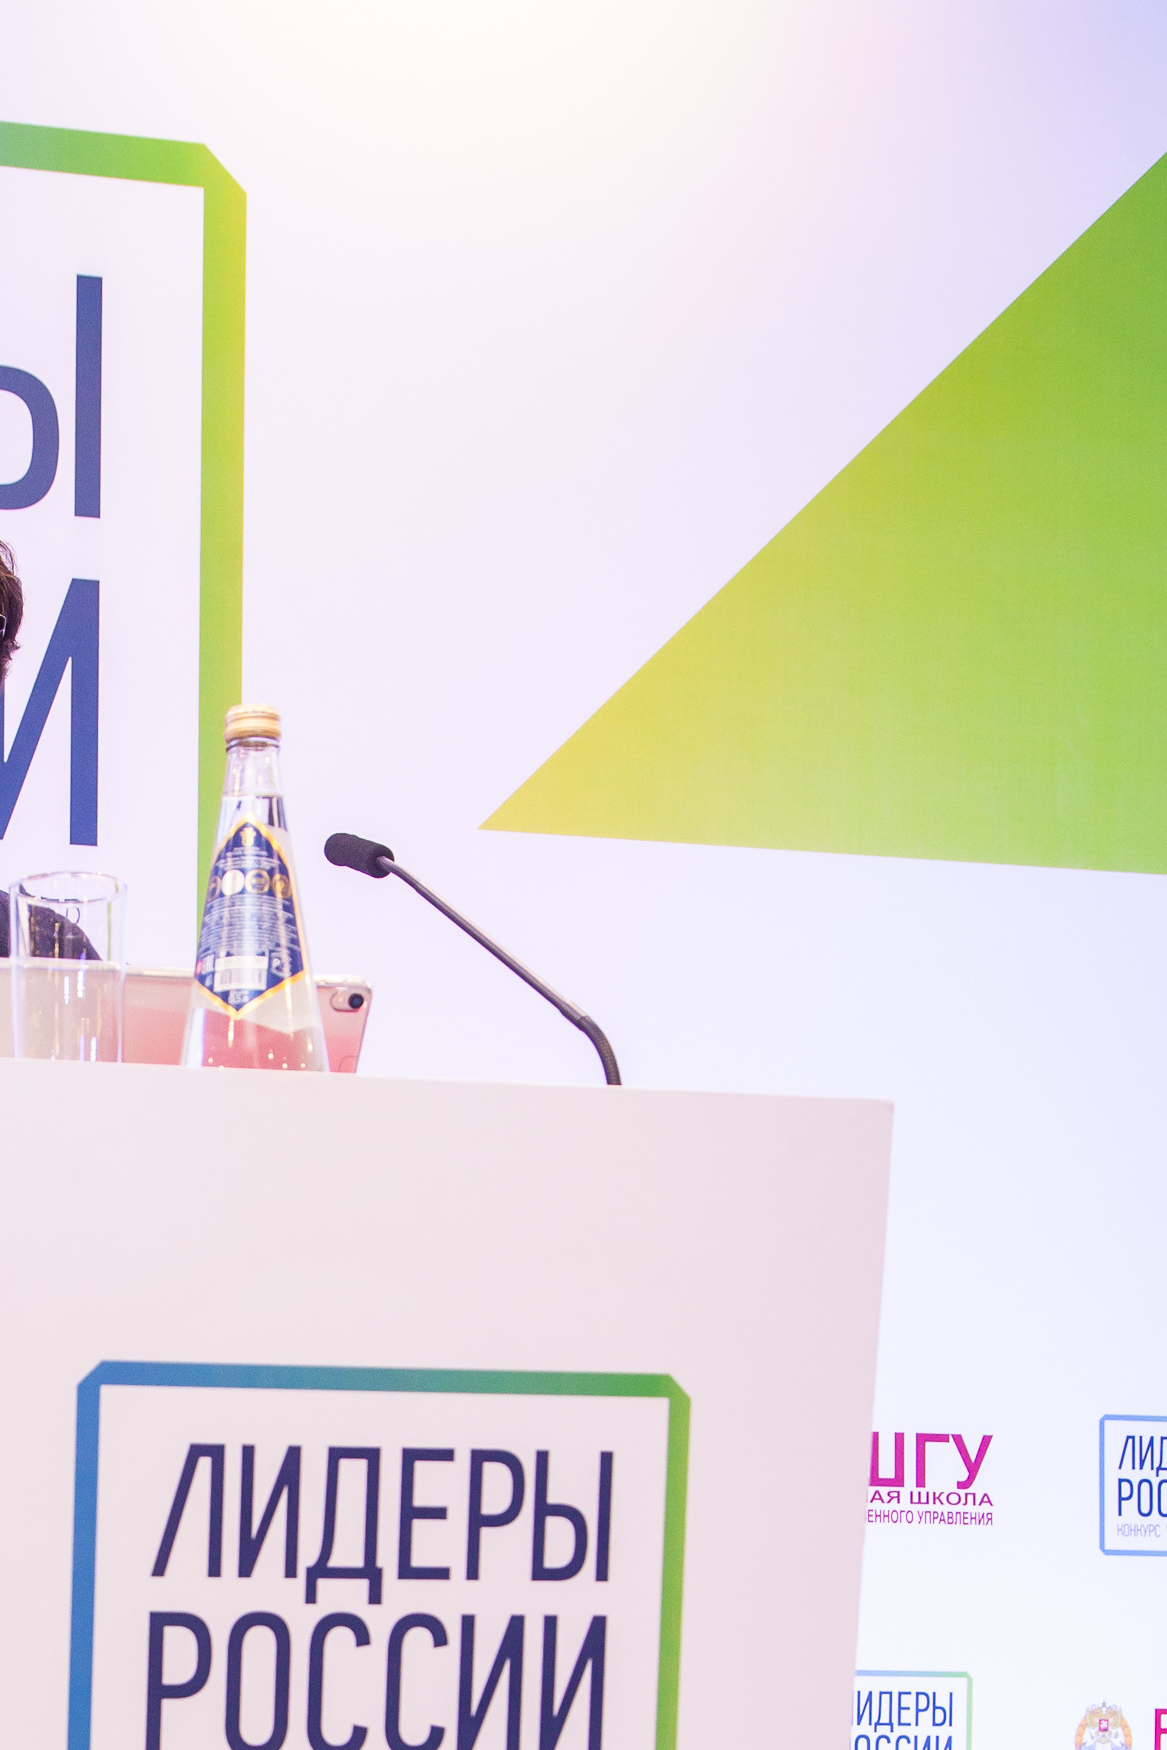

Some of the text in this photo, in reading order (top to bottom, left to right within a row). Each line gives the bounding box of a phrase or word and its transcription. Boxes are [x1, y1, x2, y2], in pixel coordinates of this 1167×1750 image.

[869, 1431, 994, 1490] ШГУ
[1118, 1435, 1167, 1477] ЛИД
[910, 1491, 994, 1507] ШКОЛА
[918, 1511, 993, 1526] УПРАВЛЕНИЯ
[1117, 1478, 1167, 1518] РОС
[150, 1443, 613, 1605] ЛИДЕРЫ
[852, 1690, 953, 1733] ИДЕРЫ
